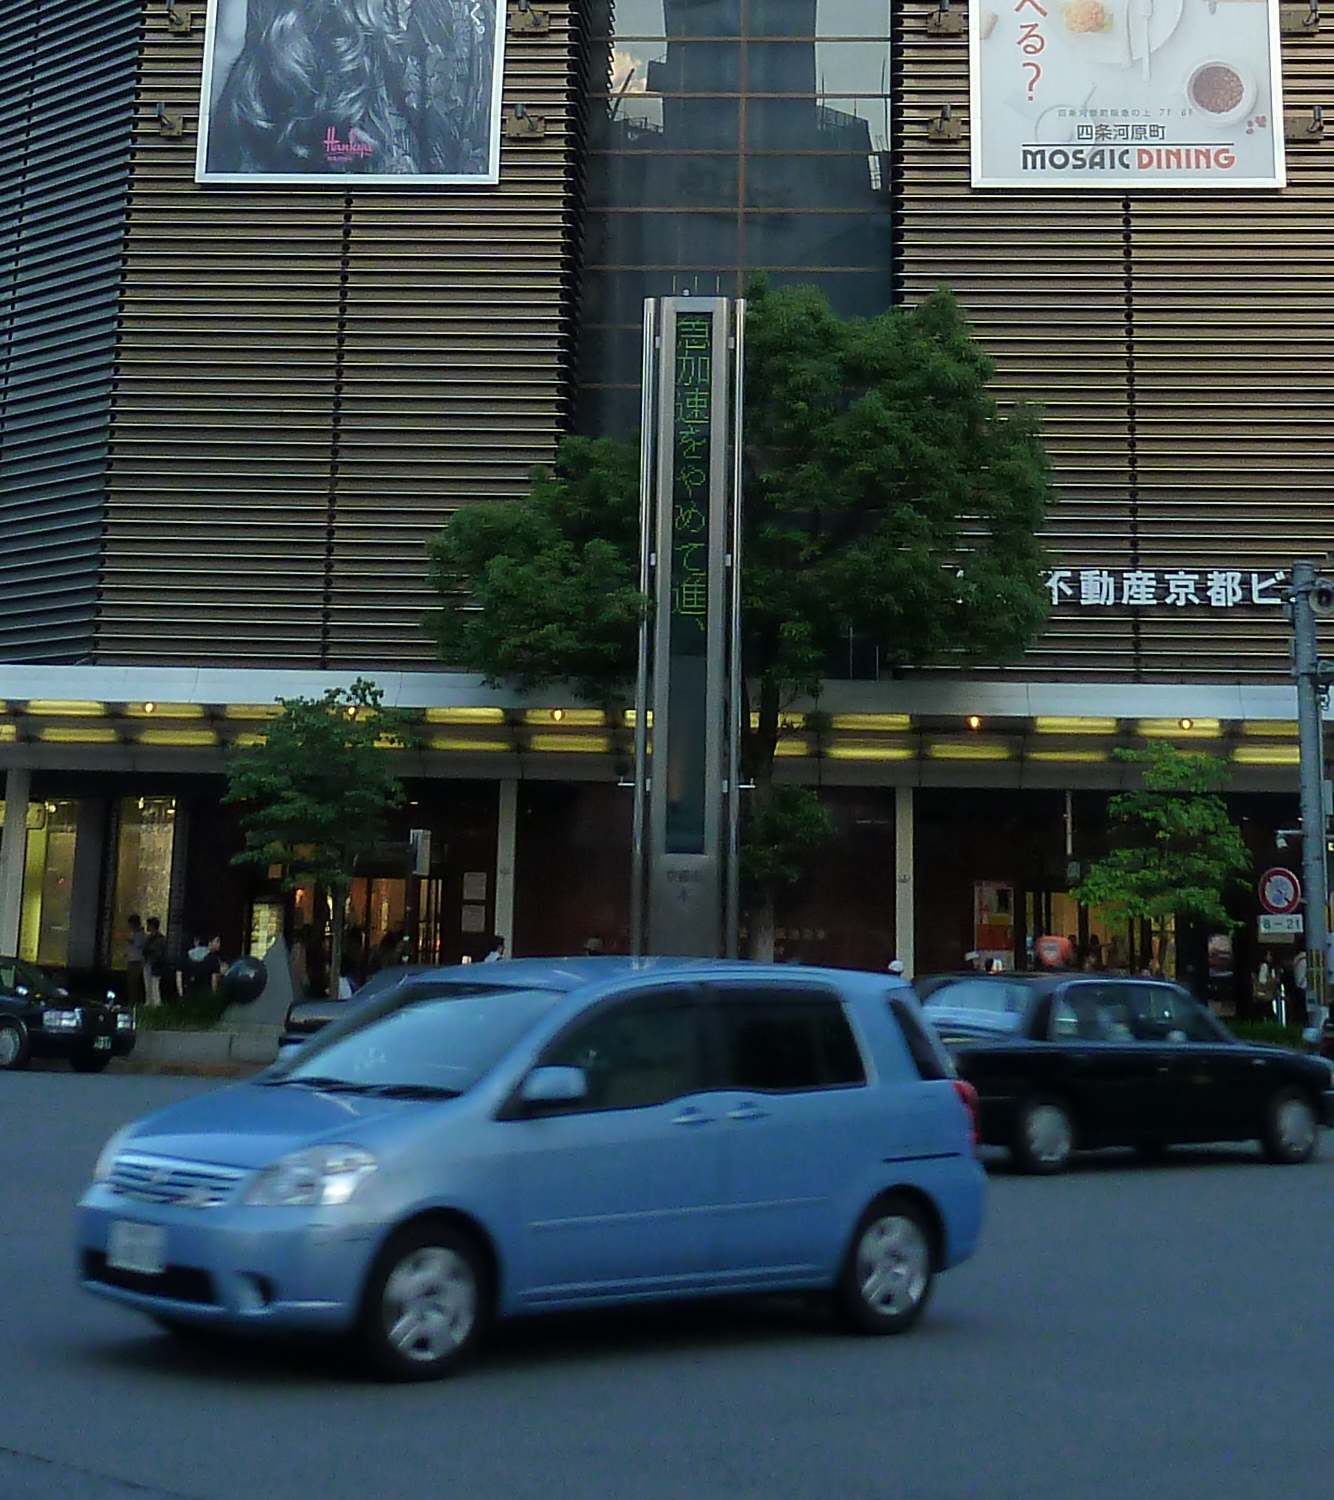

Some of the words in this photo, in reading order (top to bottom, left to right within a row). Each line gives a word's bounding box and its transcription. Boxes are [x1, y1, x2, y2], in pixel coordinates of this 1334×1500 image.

[1077, 124, 1166, 141] 四条河原町
[1022, 149, 1130, 170] MOSAIC
[1137, 149, 1235, 170] DINING
[1038, 570, 1296, 607] 不動産京都ビ
